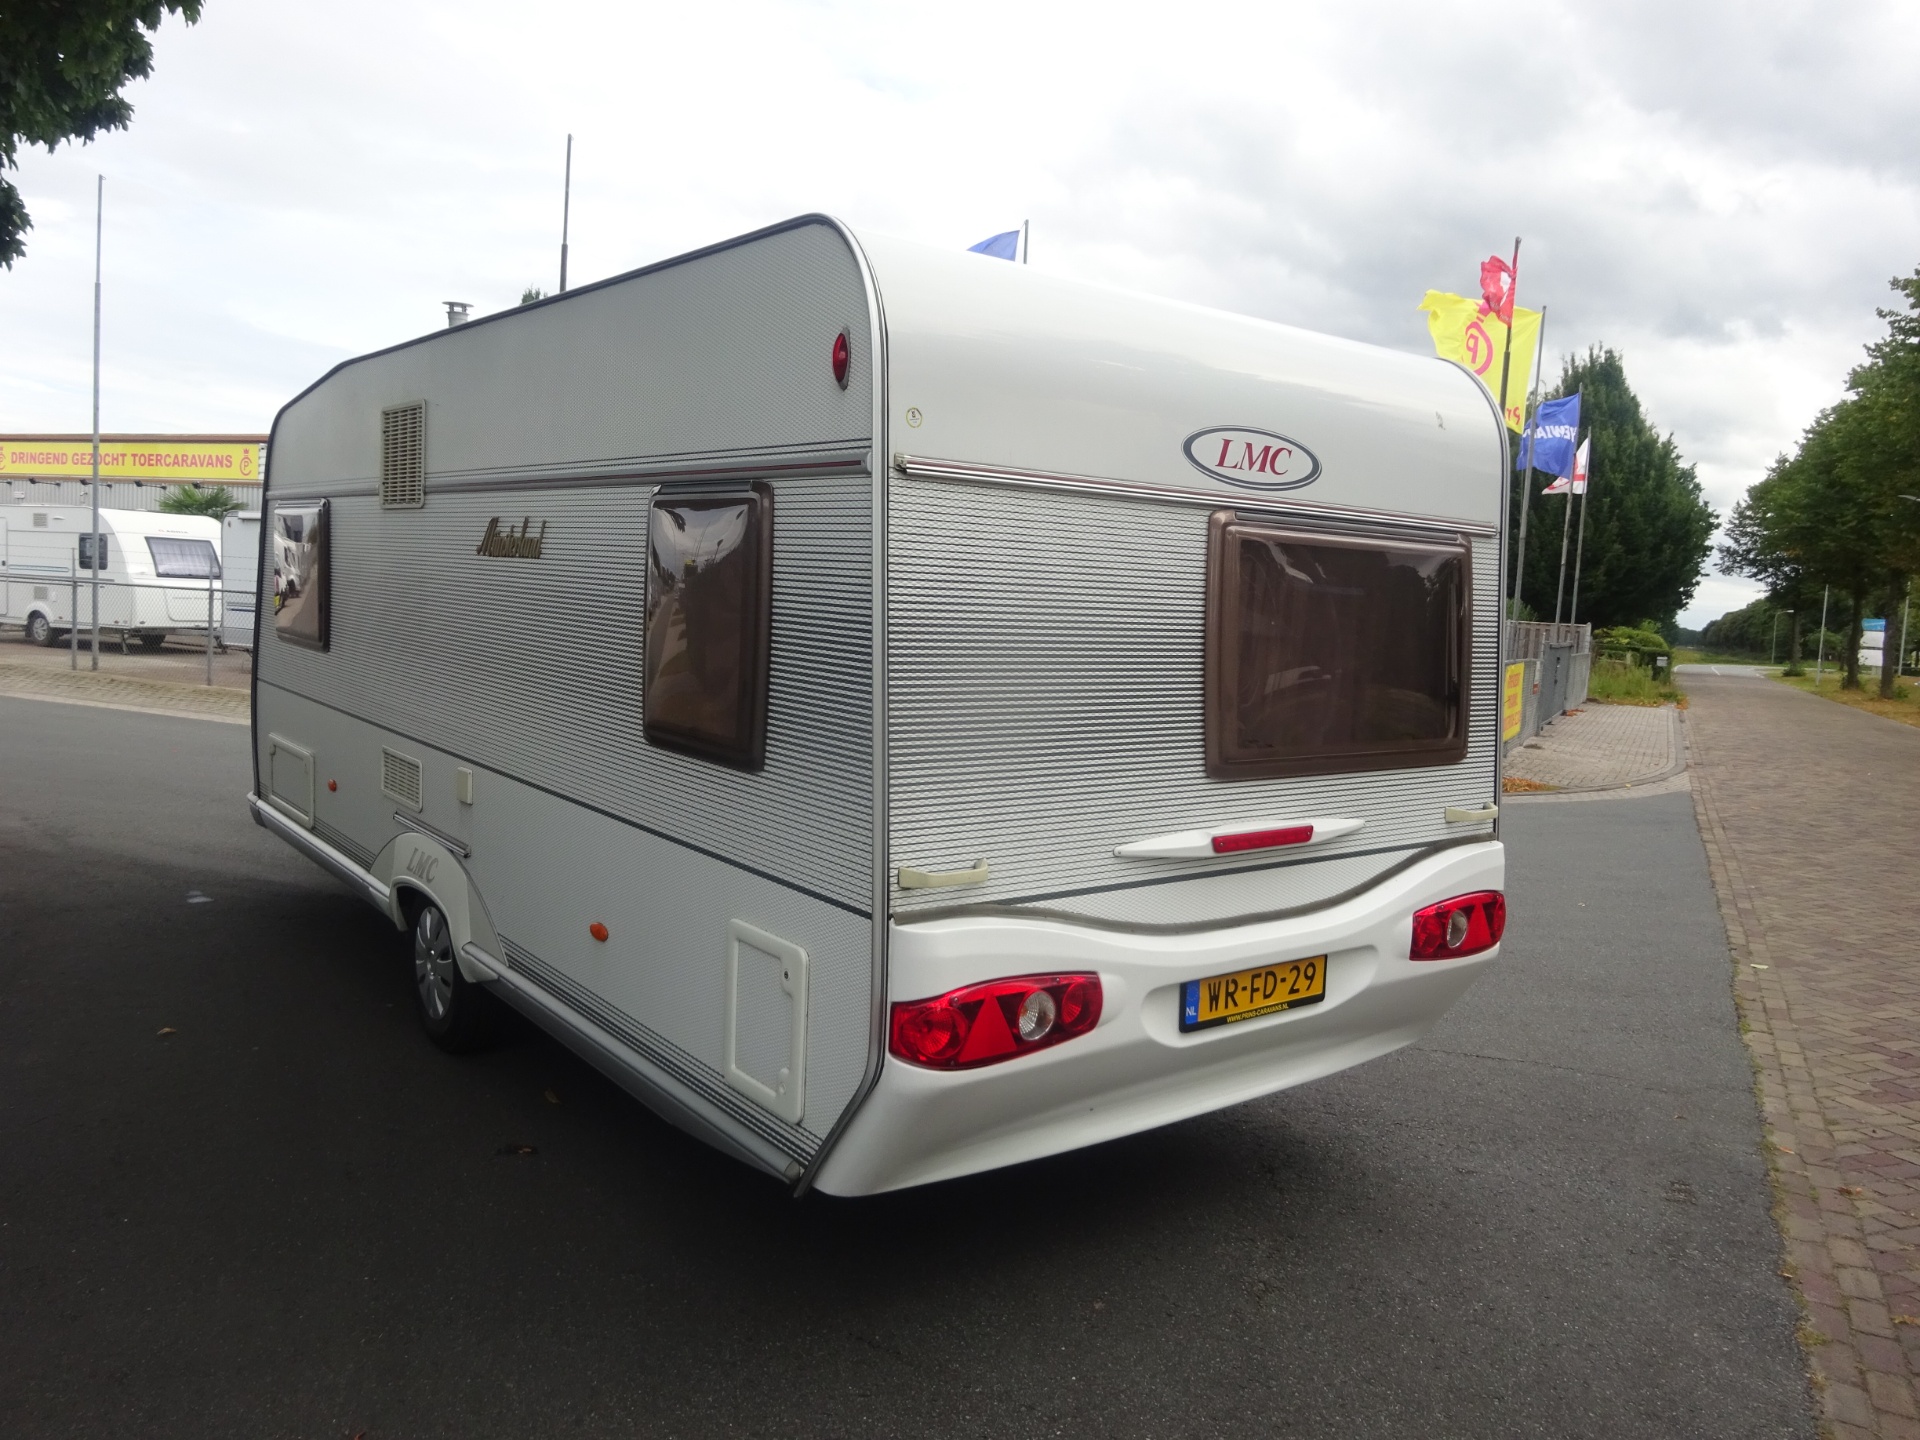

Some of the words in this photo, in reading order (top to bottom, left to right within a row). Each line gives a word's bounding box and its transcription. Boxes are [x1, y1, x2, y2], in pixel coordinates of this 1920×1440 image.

[11, 451, 68, 465] DRINGEND
[131, 453, 233, 468] TOERCARAVANS
[1214, 438, 1293, 476] LMC
[406, 846, 439, 884] LMC
[1207, 961, 1317, 1013] WR-FD-29
[1185, 1006, 1197, 1017] NL
